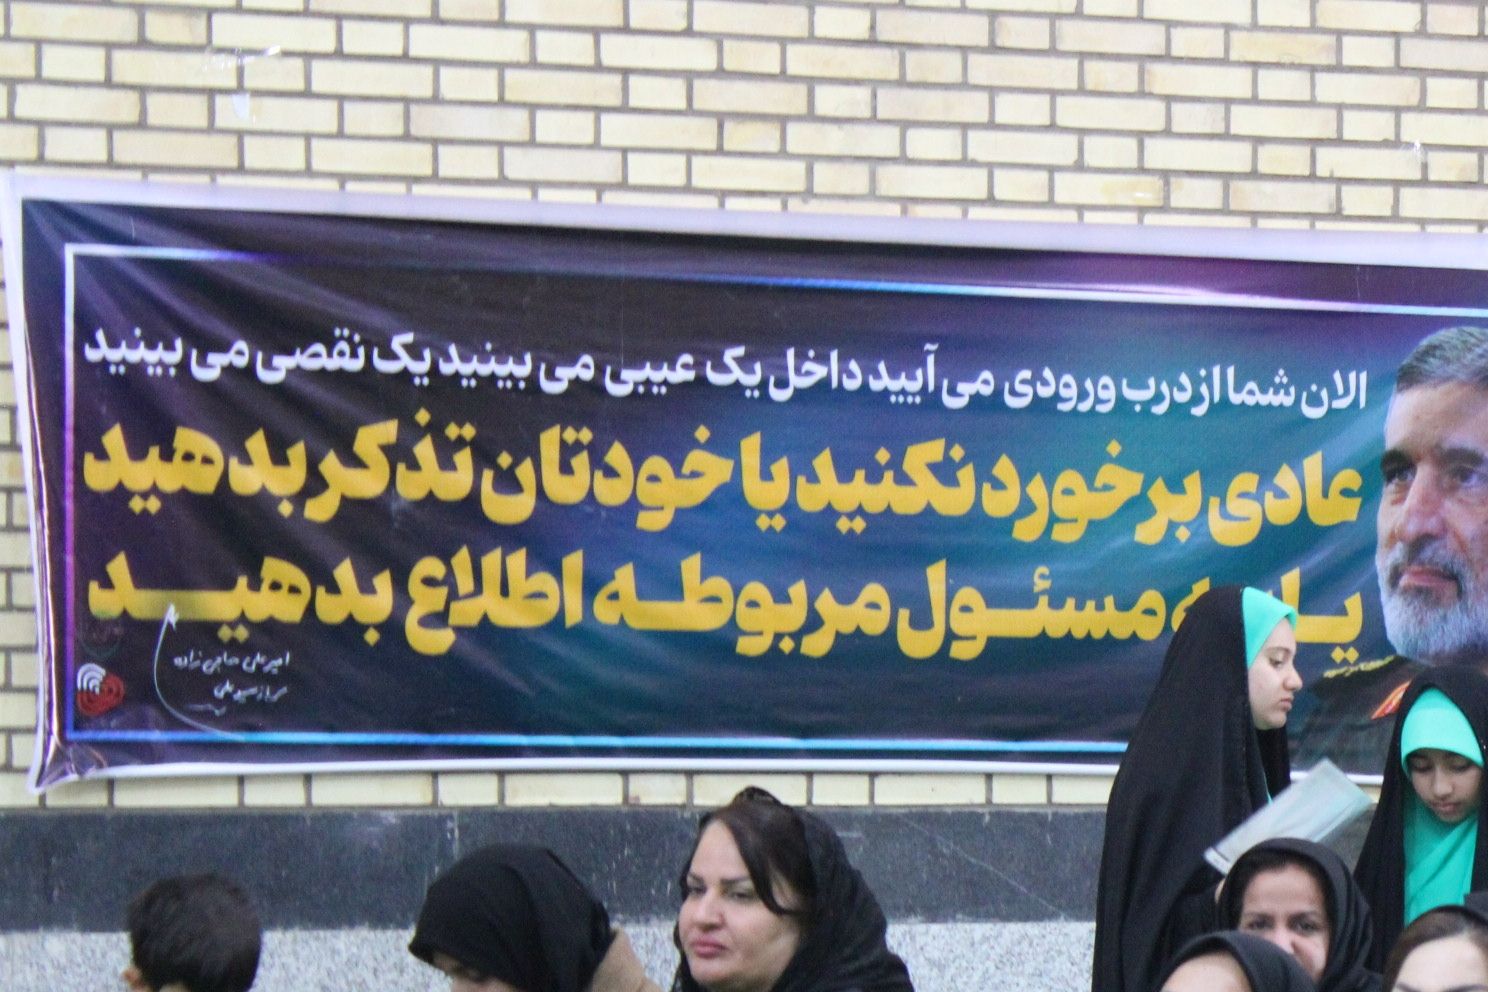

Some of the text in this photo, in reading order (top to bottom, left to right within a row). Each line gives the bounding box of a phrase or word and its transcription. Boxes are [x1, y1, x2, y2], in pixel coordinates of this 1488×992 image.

[84, 327, 1369, 419] الان شما از درب ورودی می آیید داخل یک عیبی می بینید یک نقصی می بینید
[83, 407, 1362, 546] عادی برخورد نکنید یا خودتان تذکر بدهید
[88, 551, 393, 645] بدهید
[405, 547, 584, 656] اطلاع
[593, 551, 891, 658] مربوطه
[897, 559, 1166, 661] مسئول
